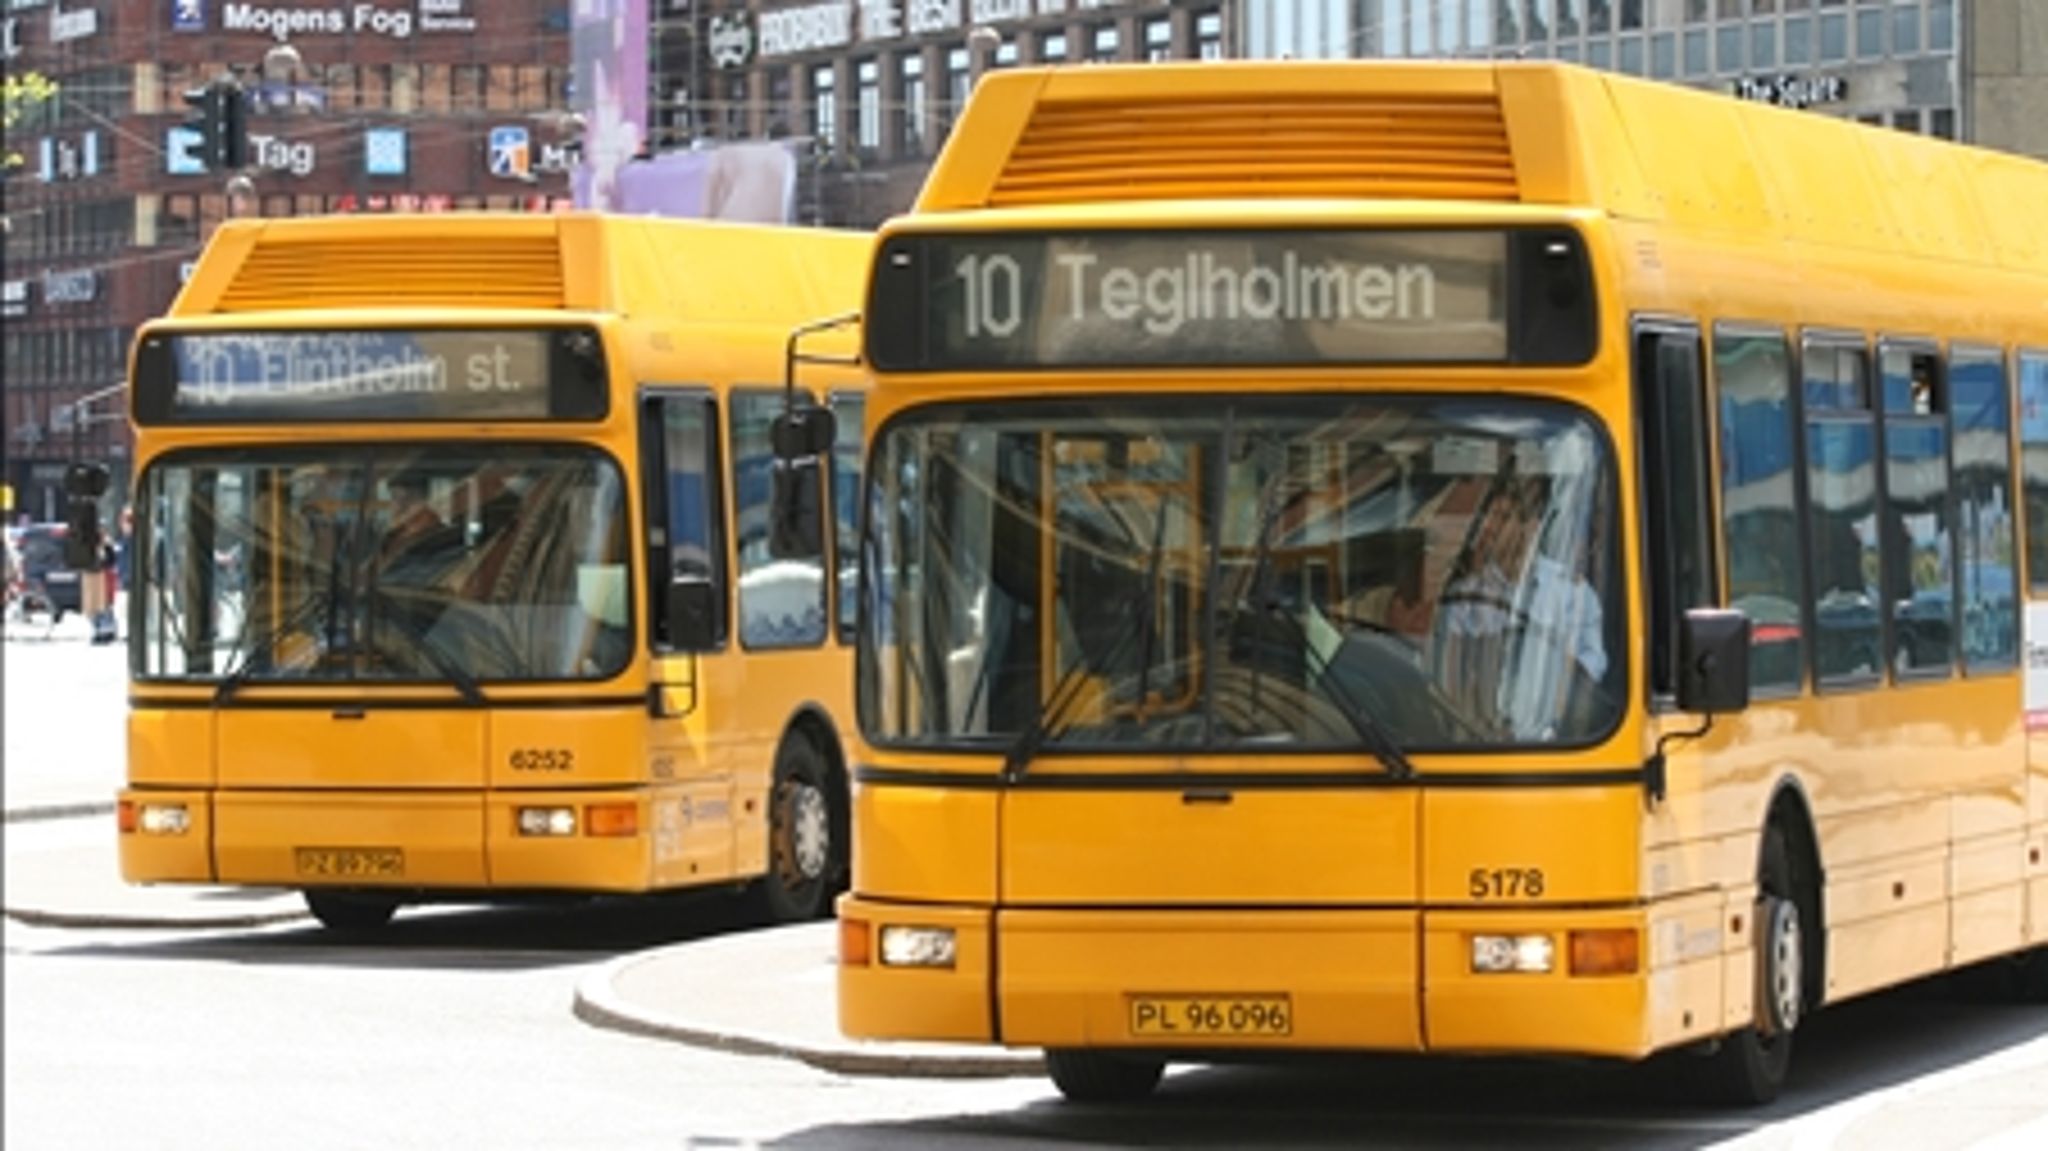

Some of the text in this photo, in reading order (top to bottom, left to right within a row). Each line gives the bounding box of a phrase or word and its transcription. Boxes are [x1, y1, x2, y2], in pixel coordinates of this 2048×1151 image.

[223, 4, 411, 40] Mogens Fog
[250, 134, 314, 175] Tag
[953, 250, 1436, 338] 10 Teglholmen
[188, 343, 236, 406] 10
[466, 344, 522, 393] st.
[508, 748, 575, 772] 6252
[1468, 867, 1545, 899] 5178
[1136, 1004, 1177, 1030] PL
